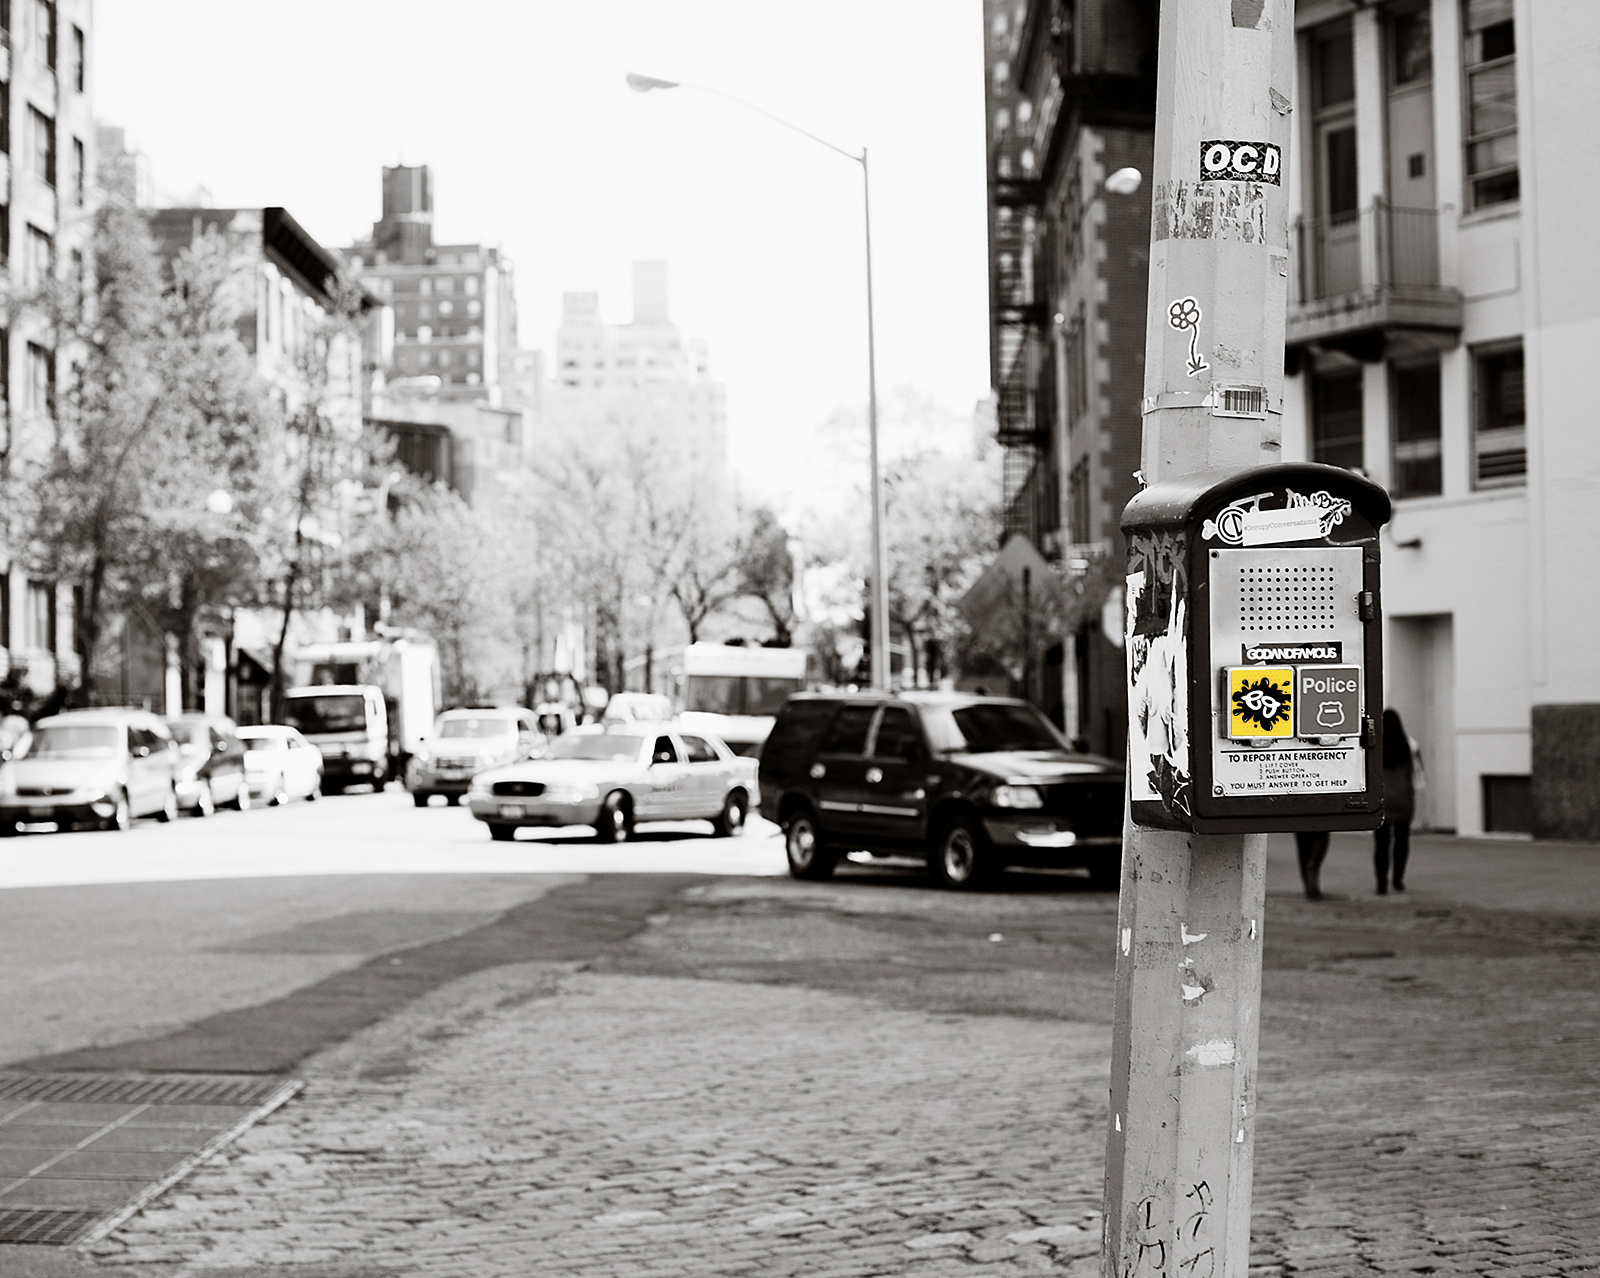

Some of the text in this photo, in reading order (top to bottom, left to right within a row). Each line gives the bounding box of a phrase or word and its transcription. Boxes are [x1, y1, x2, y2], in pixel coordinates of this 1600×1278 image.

[1246, 647, 1337, 660] GODANDFAMOUS
[1302, 677, 1357, 694] Police
[1229, 752, 1347, 763] TO REPORT AN EMERGENCY
[1268, 781, 1298, 789] ANSWER
